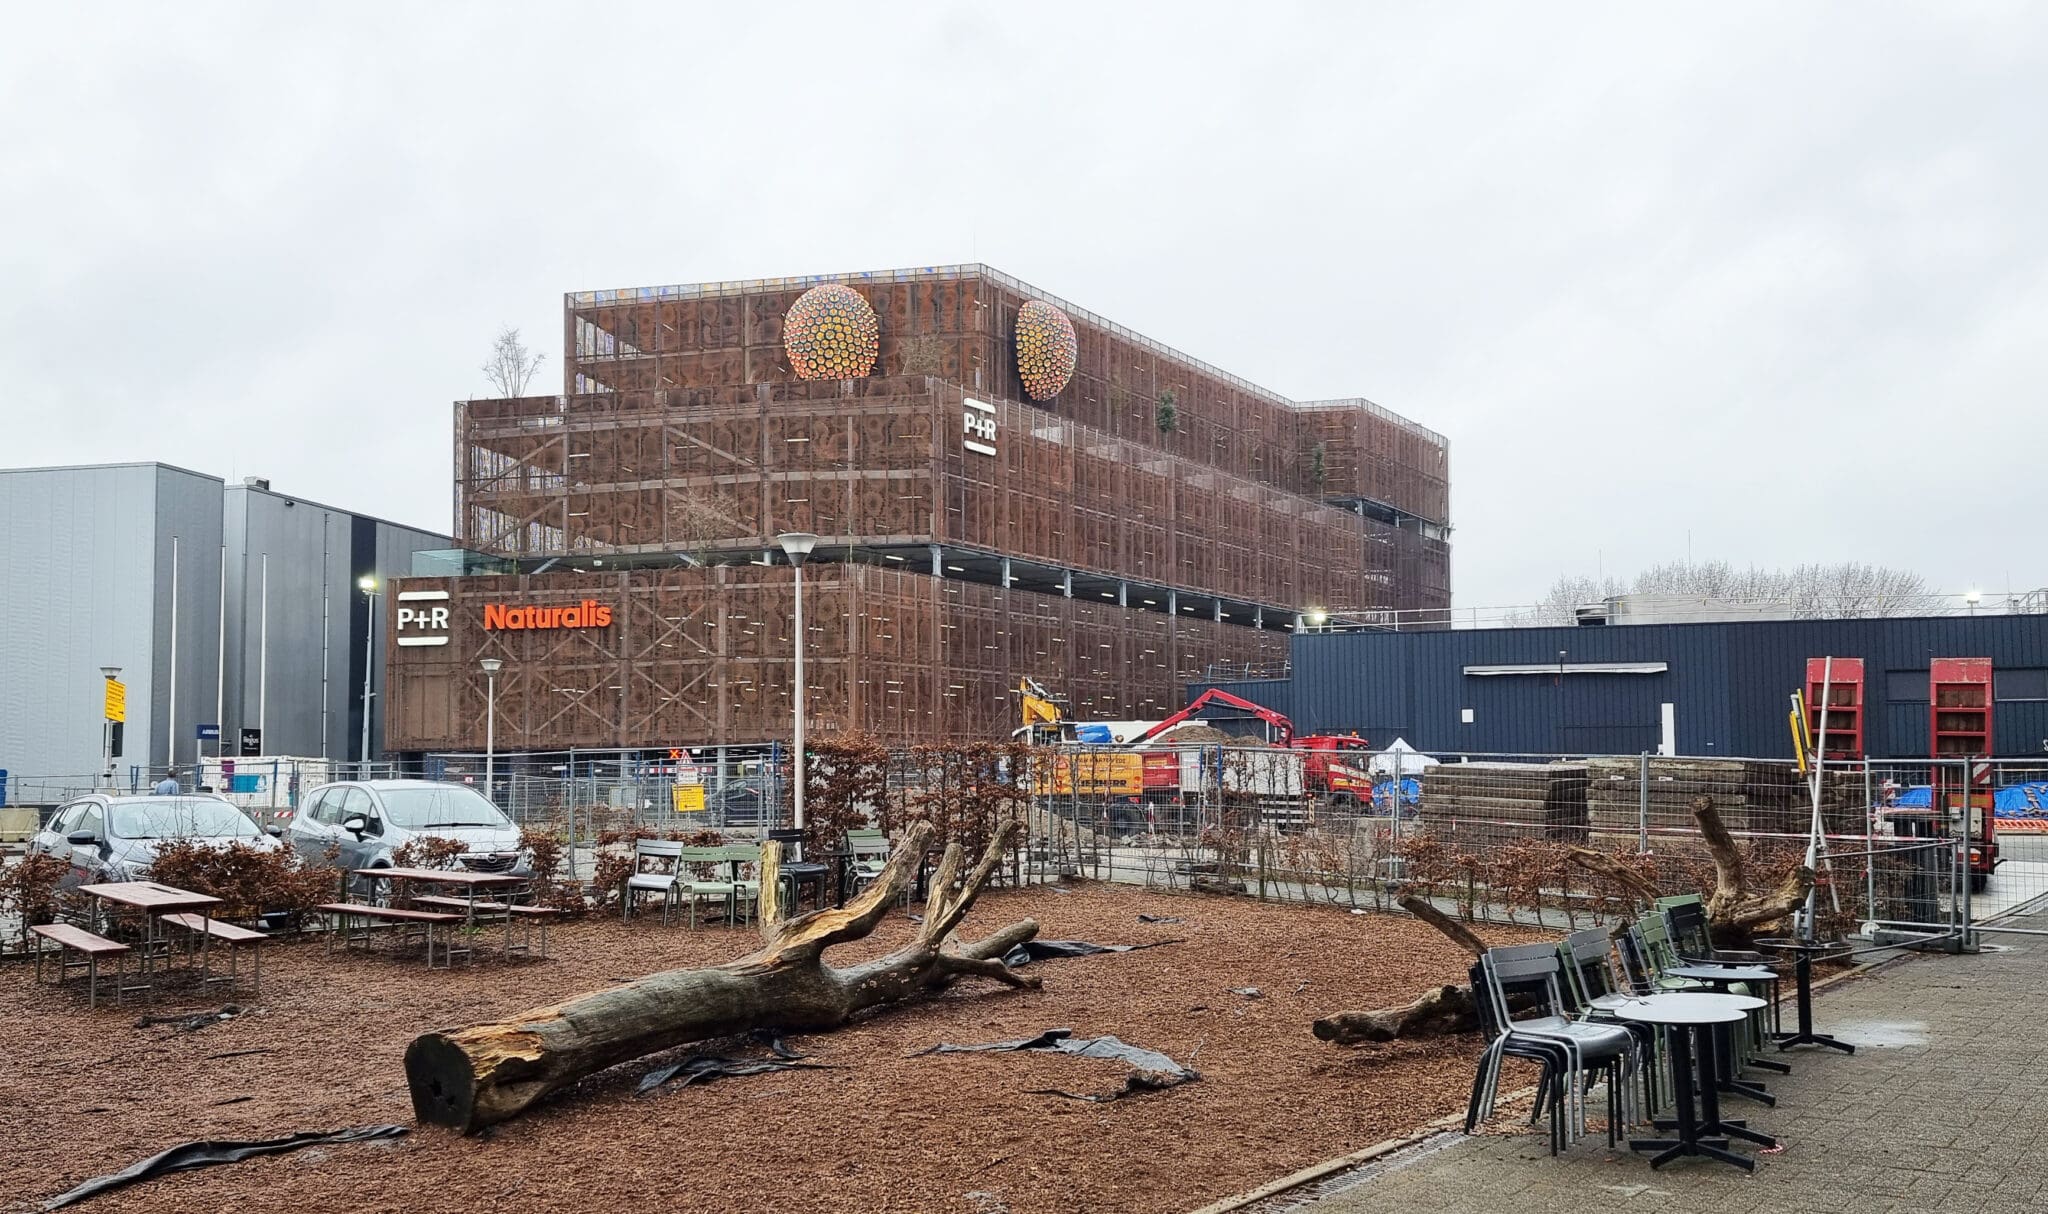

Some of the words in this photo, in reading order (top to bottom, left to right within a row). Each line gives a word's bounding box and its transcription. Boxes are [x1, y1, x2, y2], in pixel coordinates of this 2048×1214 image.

[963, 412, 996, 441] P+R
[397, 607, 448, 630] P+R
[484, 599, 612, 631] Naturalis
